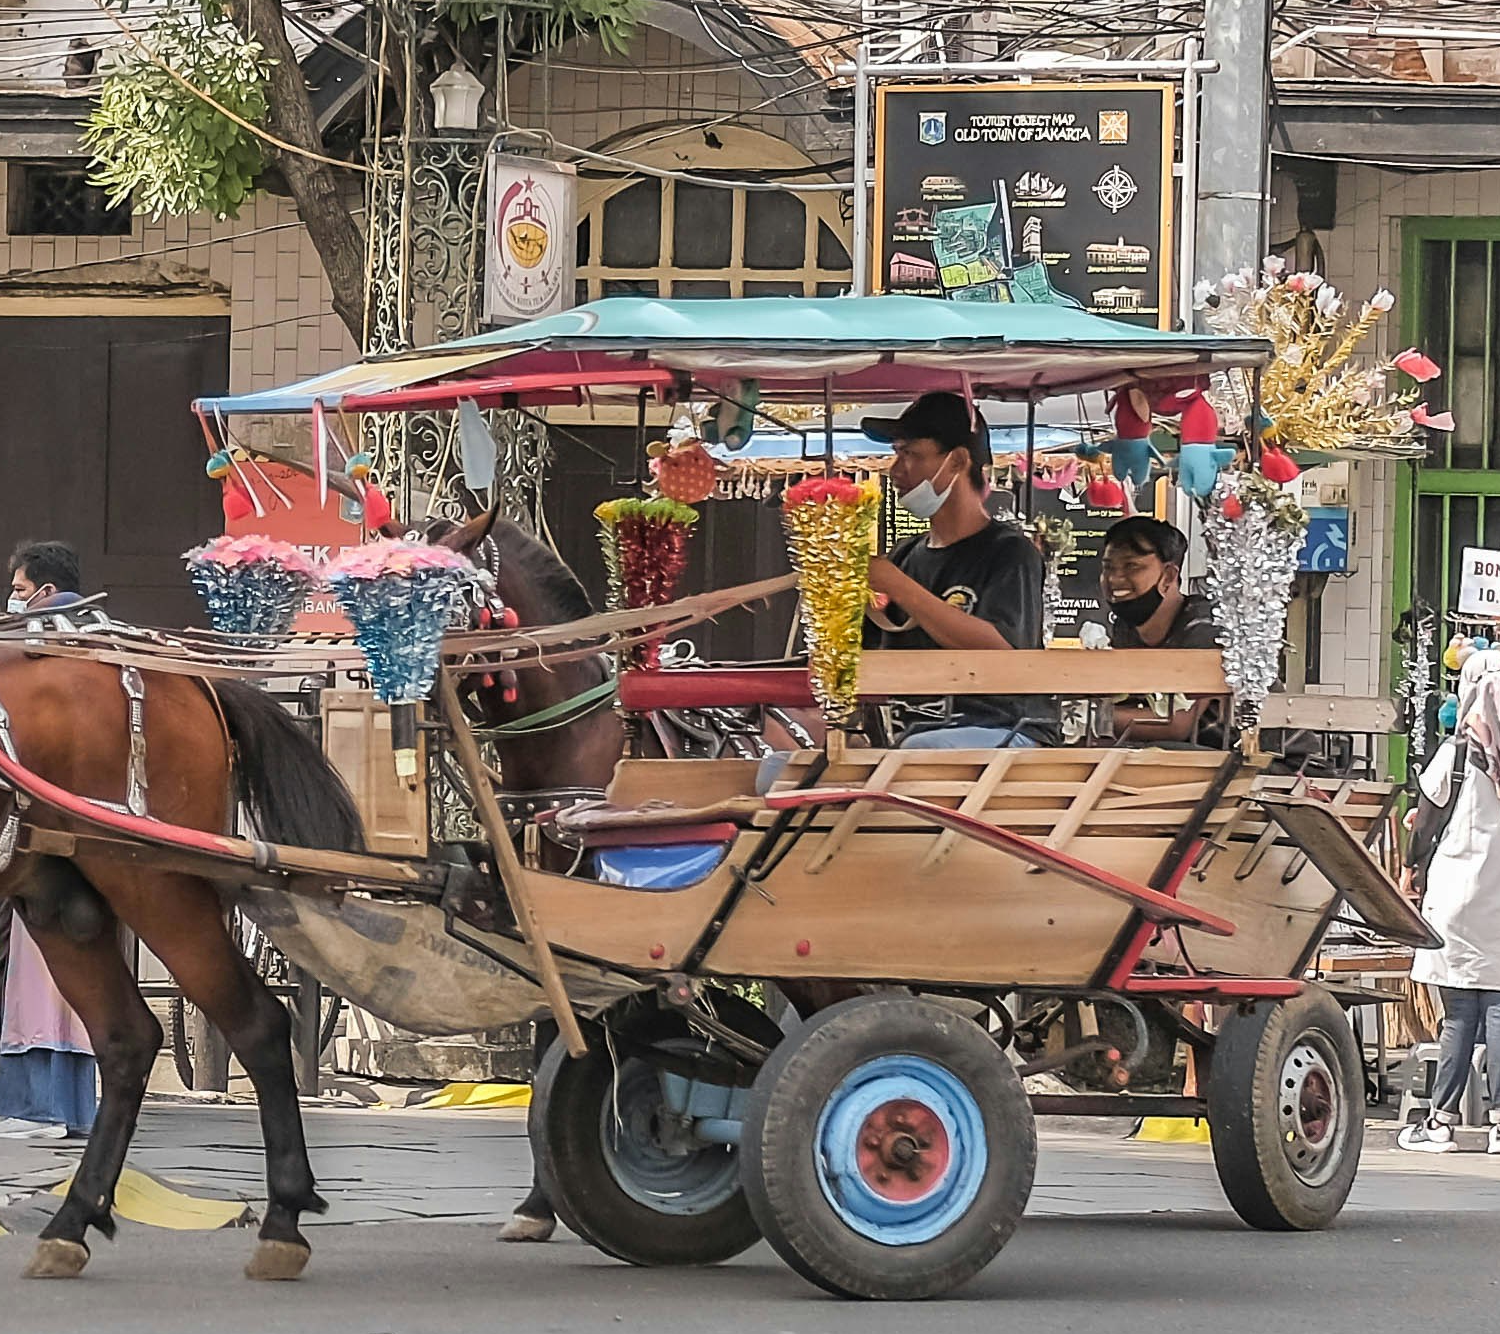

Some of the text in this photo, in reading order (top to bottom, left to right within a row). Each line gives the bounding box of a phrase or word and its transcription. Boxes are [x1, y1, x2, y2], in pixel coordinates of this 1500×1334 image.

[970, 114, 1076, 127] TOURIST OBJECT MAP
[954, 126, 1092, 141] OLD TOWN OF JAKARTA
